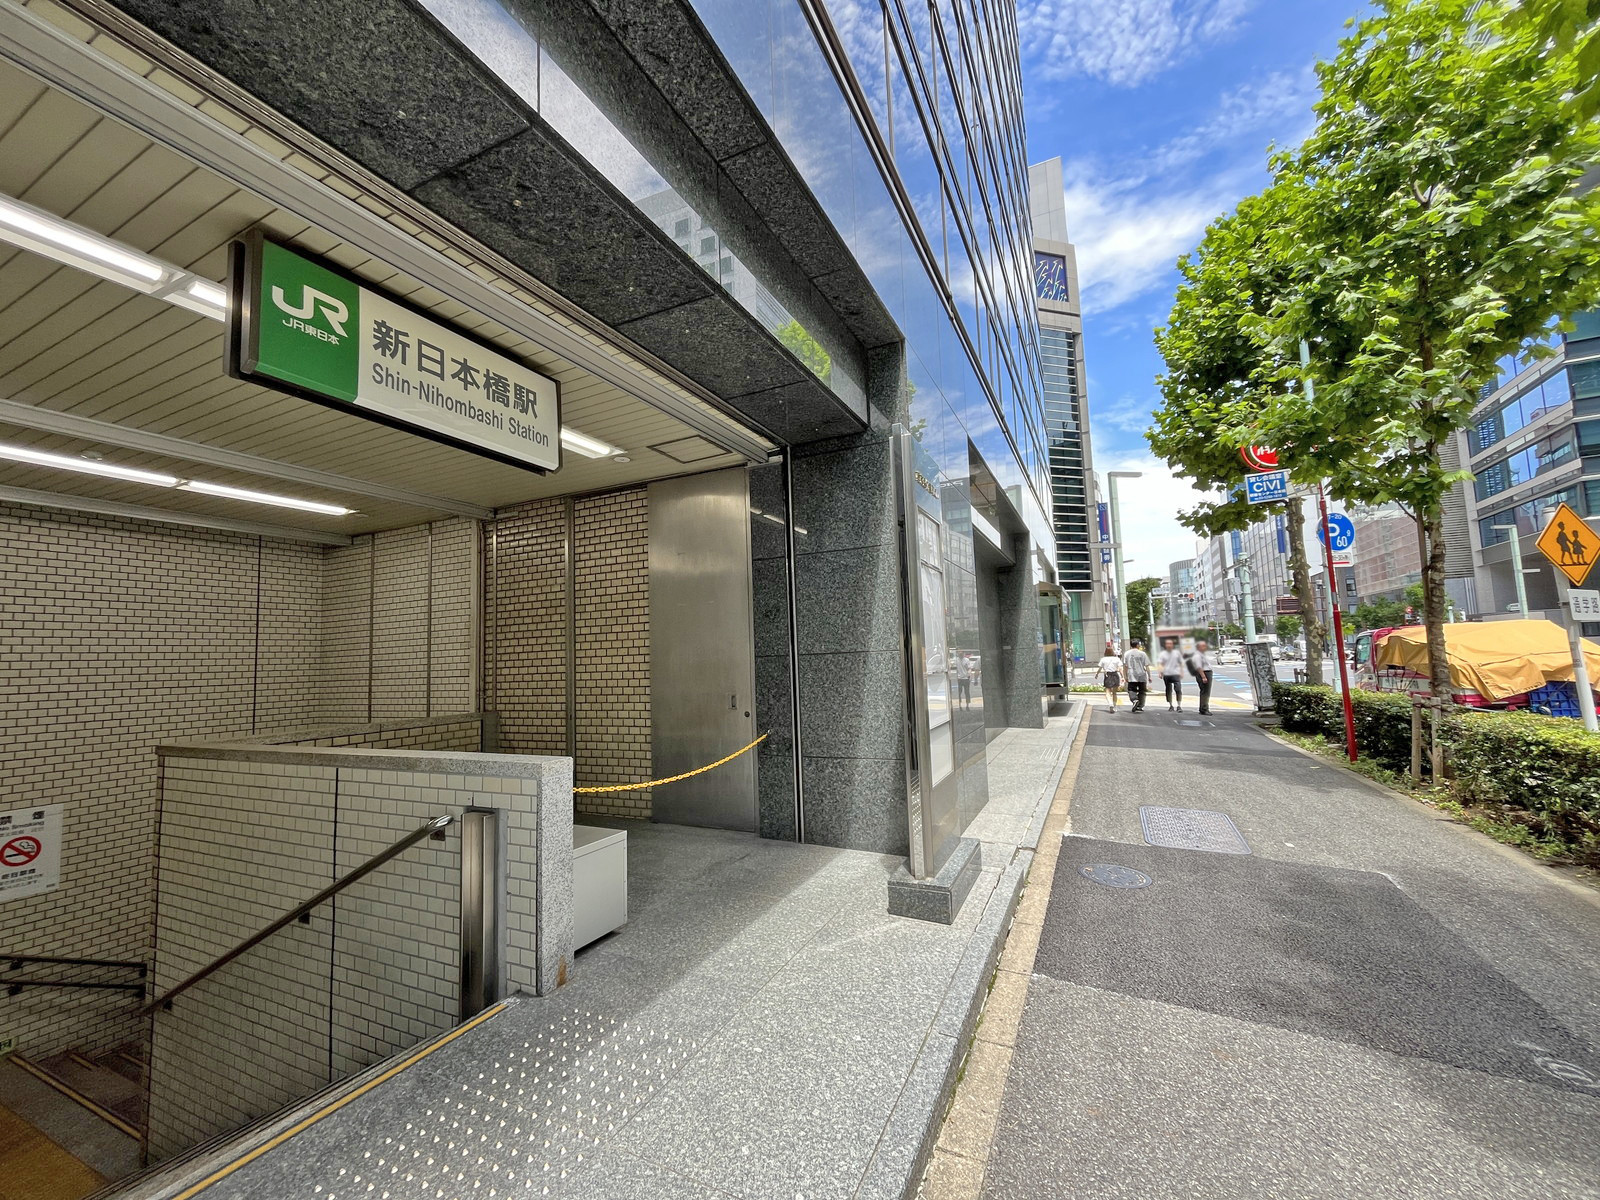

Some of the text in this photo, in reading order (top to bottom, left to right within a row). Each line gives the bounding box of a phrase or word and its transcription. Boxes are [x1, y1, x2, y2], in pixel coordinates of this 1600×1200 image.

[272, 284, 349, 338] JR
[282, 318, 339, 345] JR東日本
[372, 319, 538, 419] 新日本橋駅
[372, 362, 549, 447] Shin-Nihombashi Station
[1253, 479, 1281, 493] CIVI
[1336, 535, 1348, 547] 60
